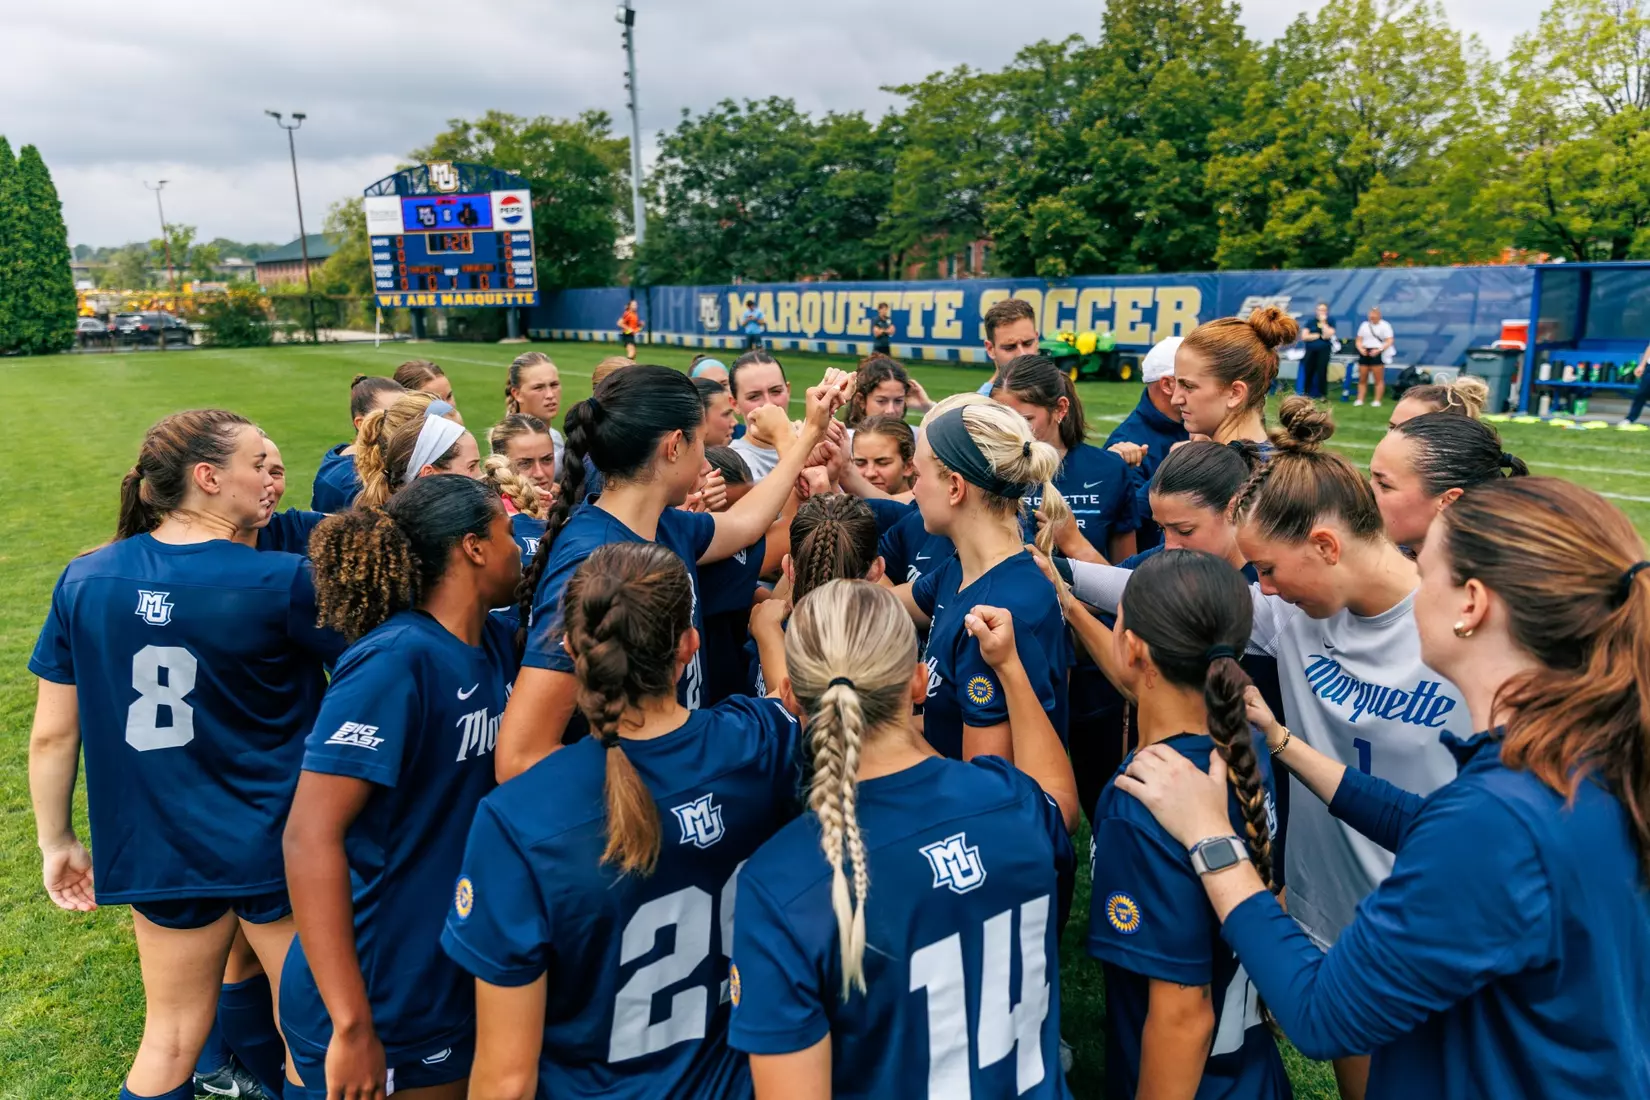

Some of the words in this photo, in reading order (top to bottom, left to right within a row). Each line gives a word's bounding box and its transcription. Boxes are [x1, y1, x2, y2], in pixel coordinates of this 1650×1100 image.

[378, 294, 402, 306] WE
[406, 294, 437, 306] ARE
[440, 292, 535, 306] MARQUETTE
[135, 589, 174, 626] MU
[125, 644, 197, 752] 8
[1304, 654, 1457, 728] Marquette
[331, 730, 385, 748] EAST
[340, 720, 379, 735] BIG
[670, 792, 726, 849] MU
[918, 831, 987, 894] MU
[909, 894, 1050, 1100] 14
